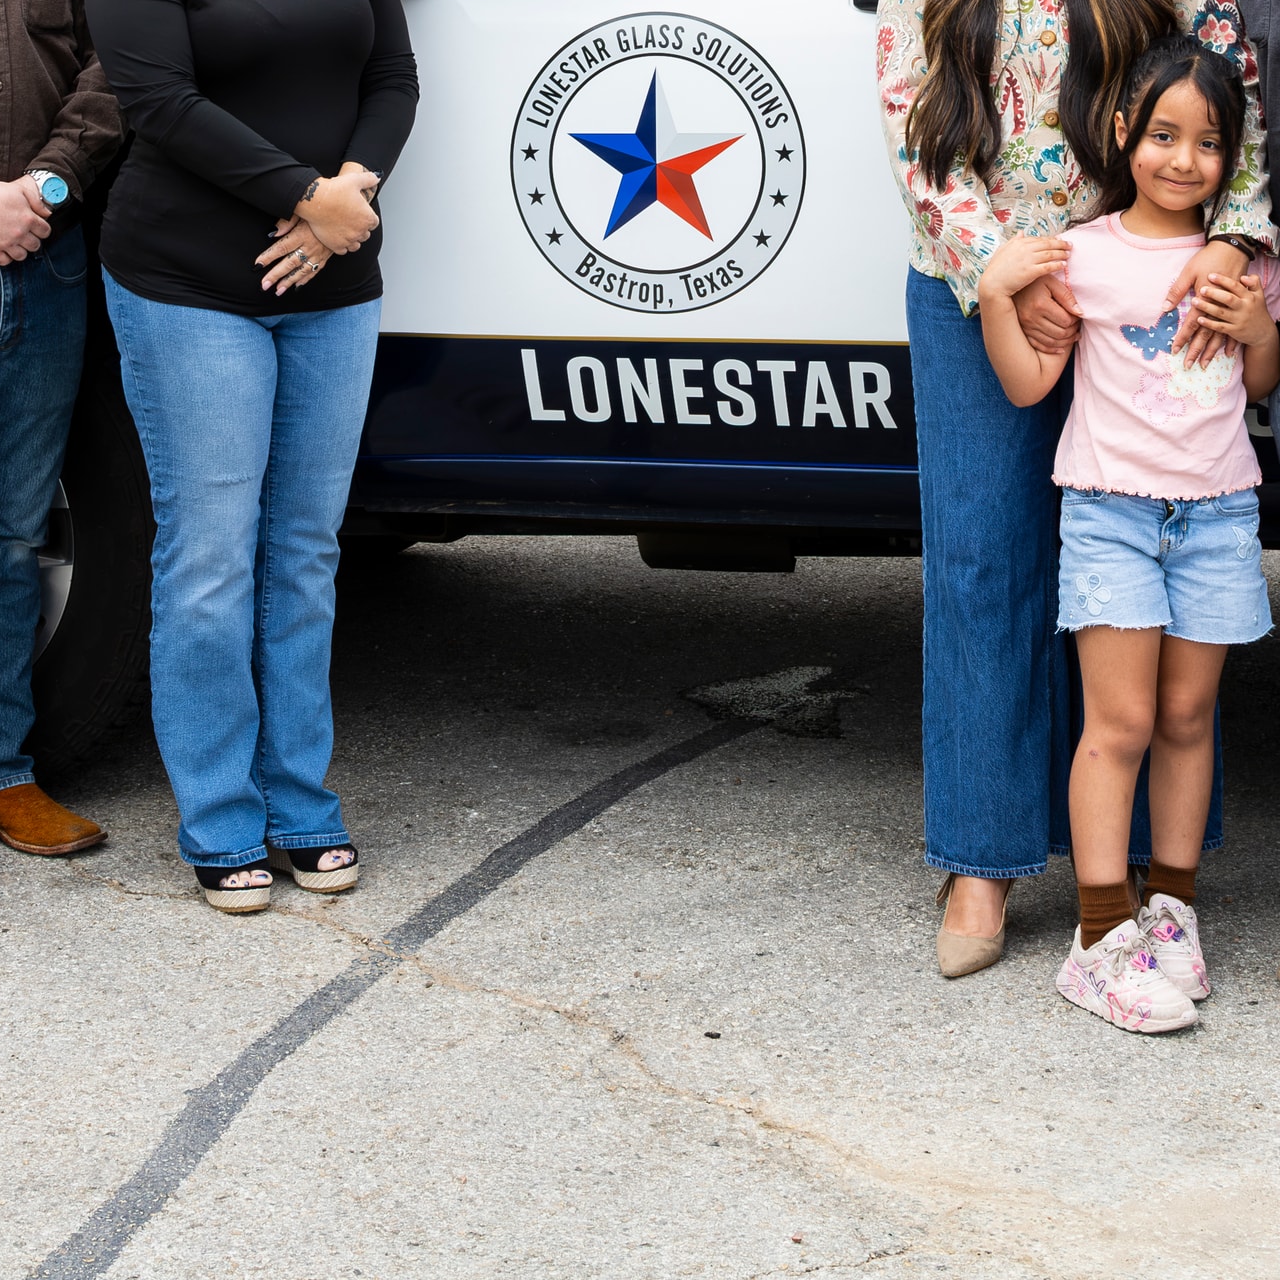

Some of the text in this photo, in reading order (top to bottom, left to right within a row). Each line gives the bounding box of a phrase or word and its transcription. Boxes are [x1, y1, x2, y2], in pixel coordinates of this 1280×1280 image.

[526, 24, 789, 129] LONESTAR GLASS SOLUTIONS
[575, 251, 744, 309] Bastrop, Texas
[521, 348, 898, 429] LONESTAR
